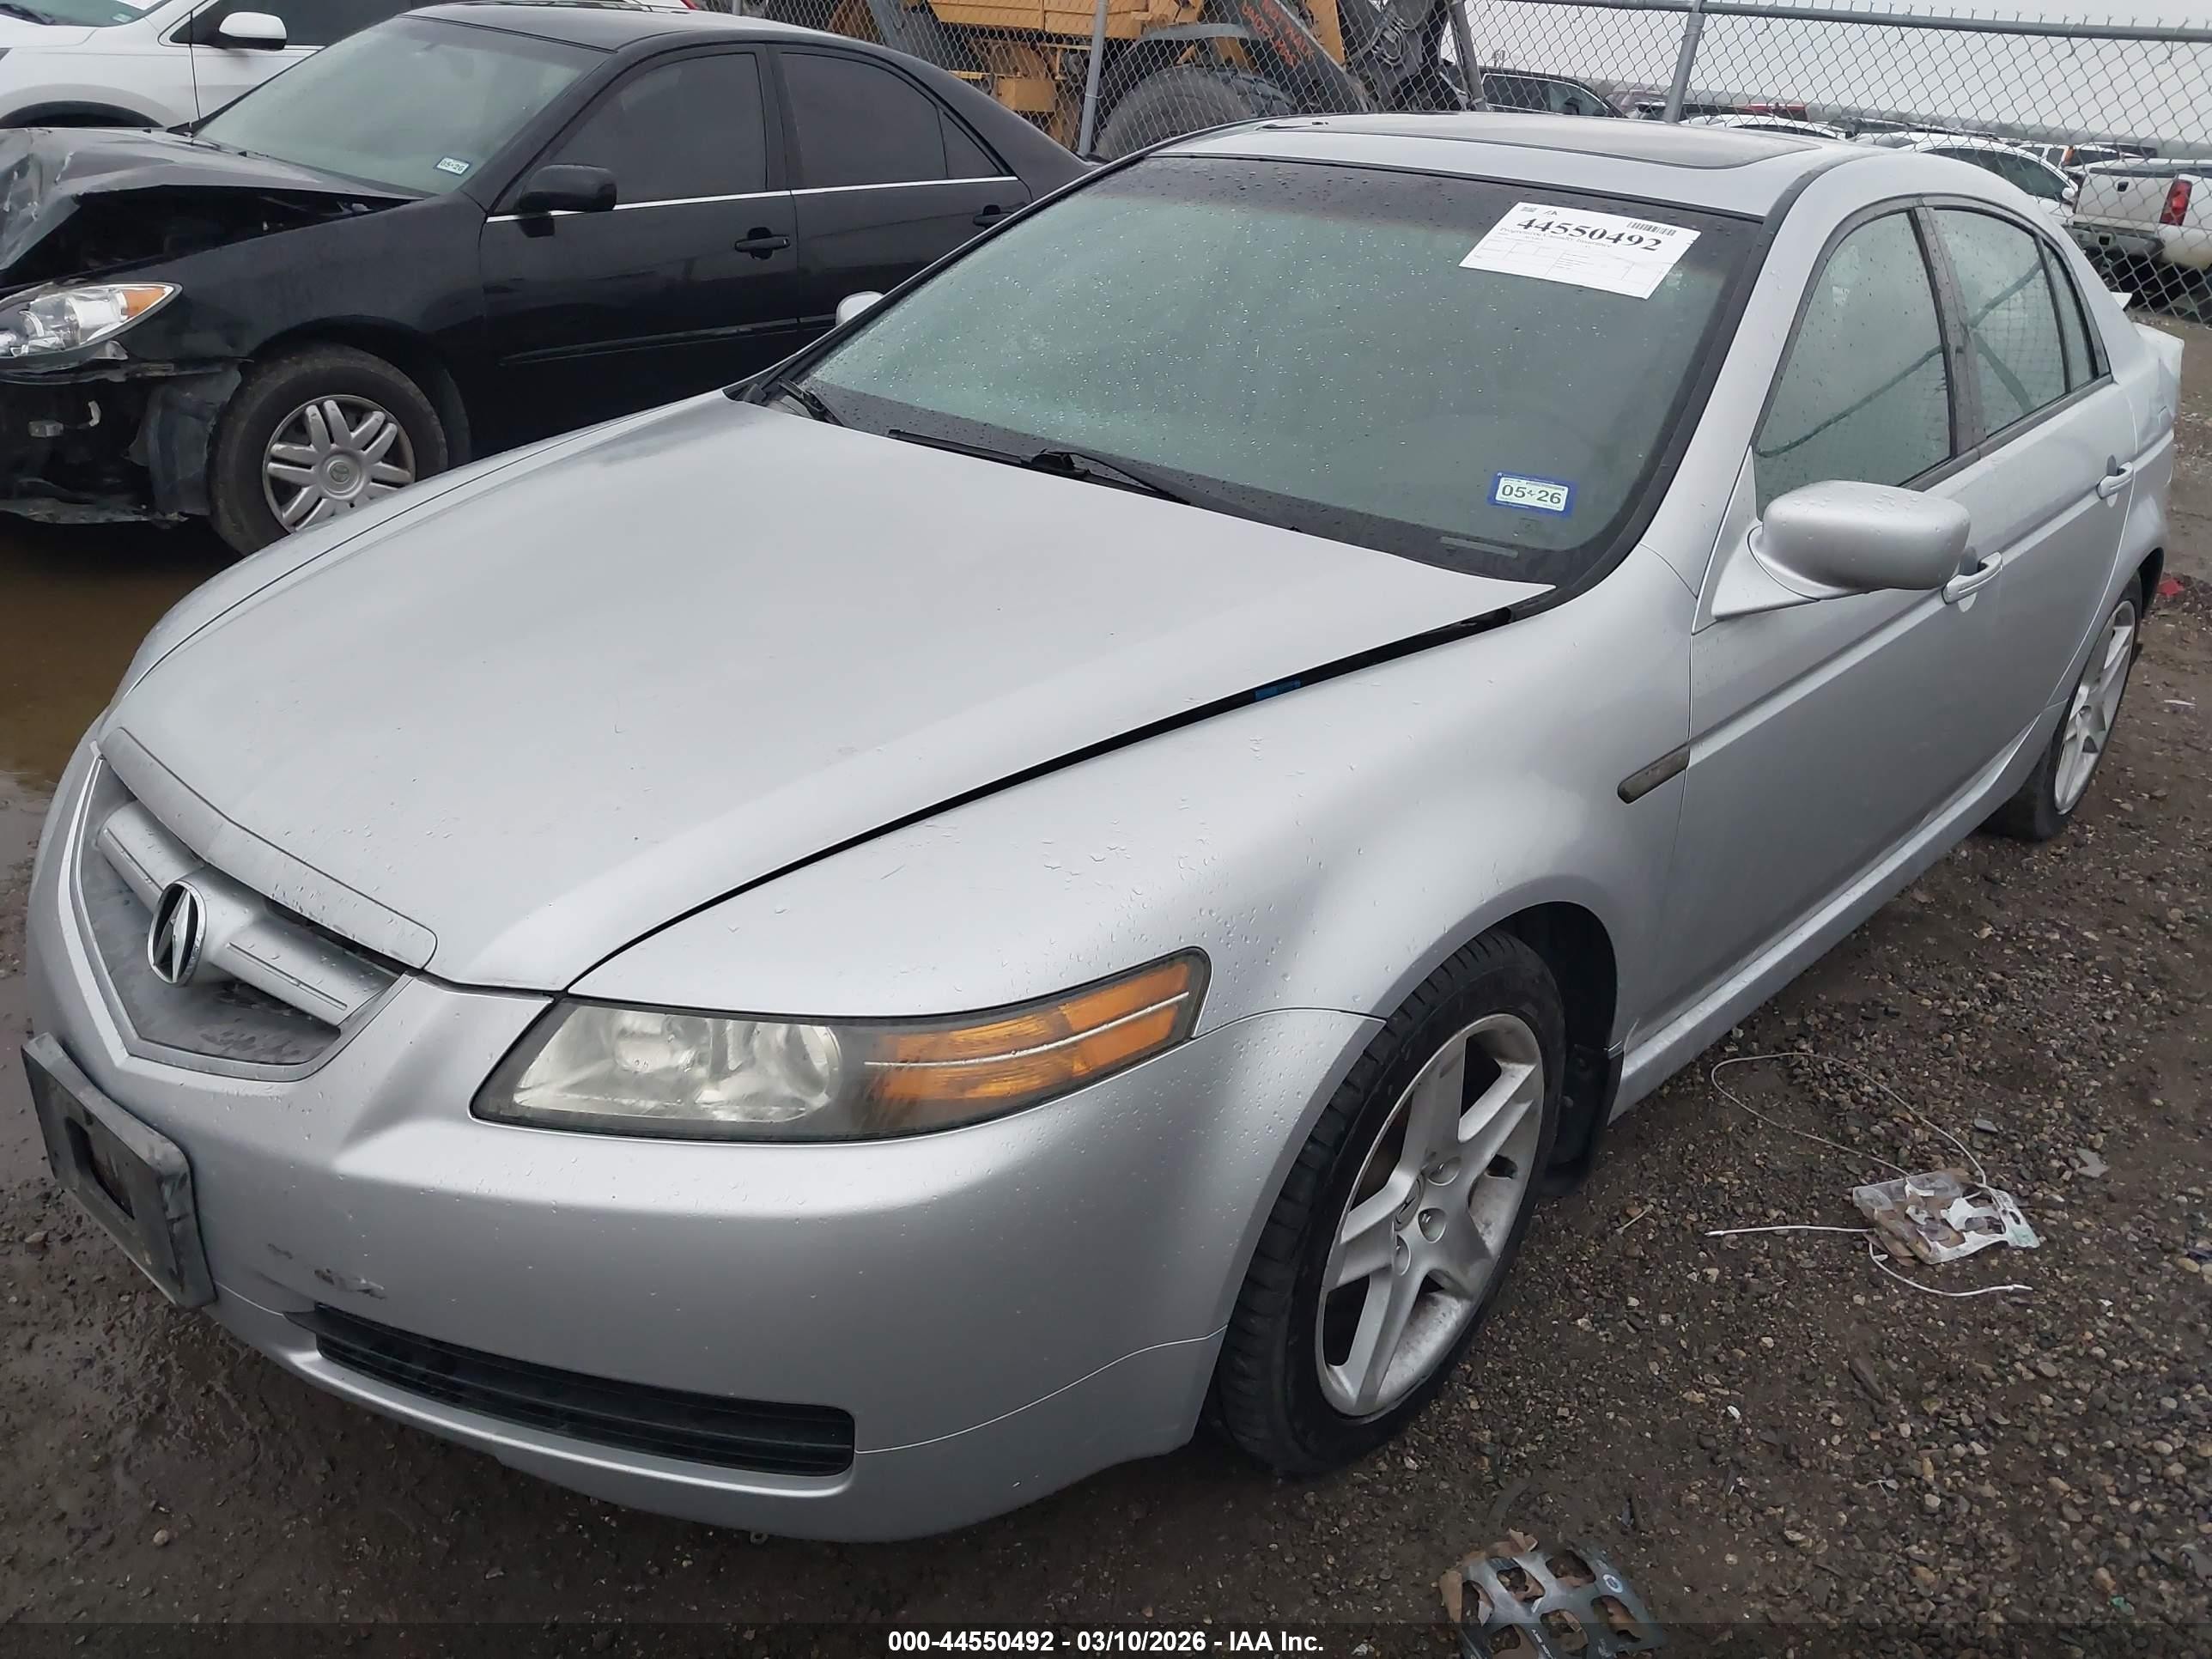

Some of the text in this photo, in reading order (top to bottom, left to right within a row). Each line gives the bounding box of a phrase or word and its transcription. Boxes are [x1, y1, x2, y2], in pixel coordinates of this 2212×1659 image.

[1516, 217, 1663, 252] 44550492
[1501, 484, 1526, 498] 05
[1537, 489, 1562, 505] 26
